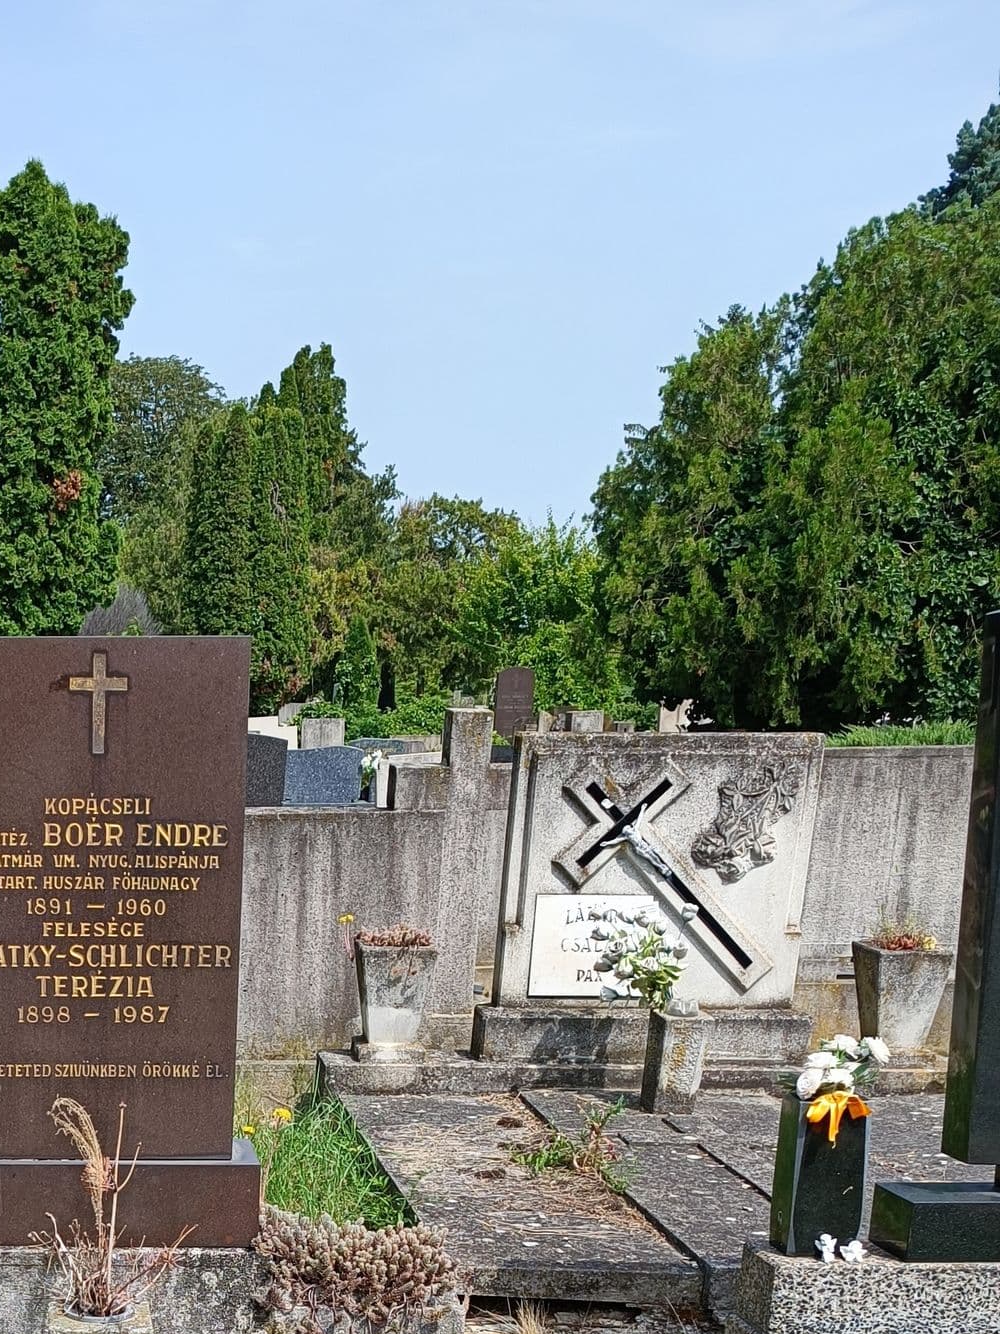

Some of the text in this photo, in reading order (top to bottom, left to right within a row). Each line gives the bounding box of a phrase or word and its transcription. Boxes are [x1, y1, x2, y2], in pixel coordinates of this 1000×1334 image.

[44, 793, 151, 815] KOPÁCSELI
[43, 817, 122, 847] BOÉR
[136, 823, 228, 847] ENDRE
[89, 855, 132, 869] NYUG.
[134, 850, 220, 869] ALISPÁNJA
[43, 872, 105, 890] HUSZÁR
[26, 898, 72, 915] 1891
[117, 898, 166, 916] 1960
[42, 917, 144, 937] FELESÉGE
[35, 970, 154, 998] TERÉZIA
[17, 1005, 71, 1023] 1898
[113, 1005, 170, 1023] 1987
[54, 1061, 137, 1078] SZIVÜNKBEN
[142, 1060, 200, 1078] ÖRÖKKÉ
